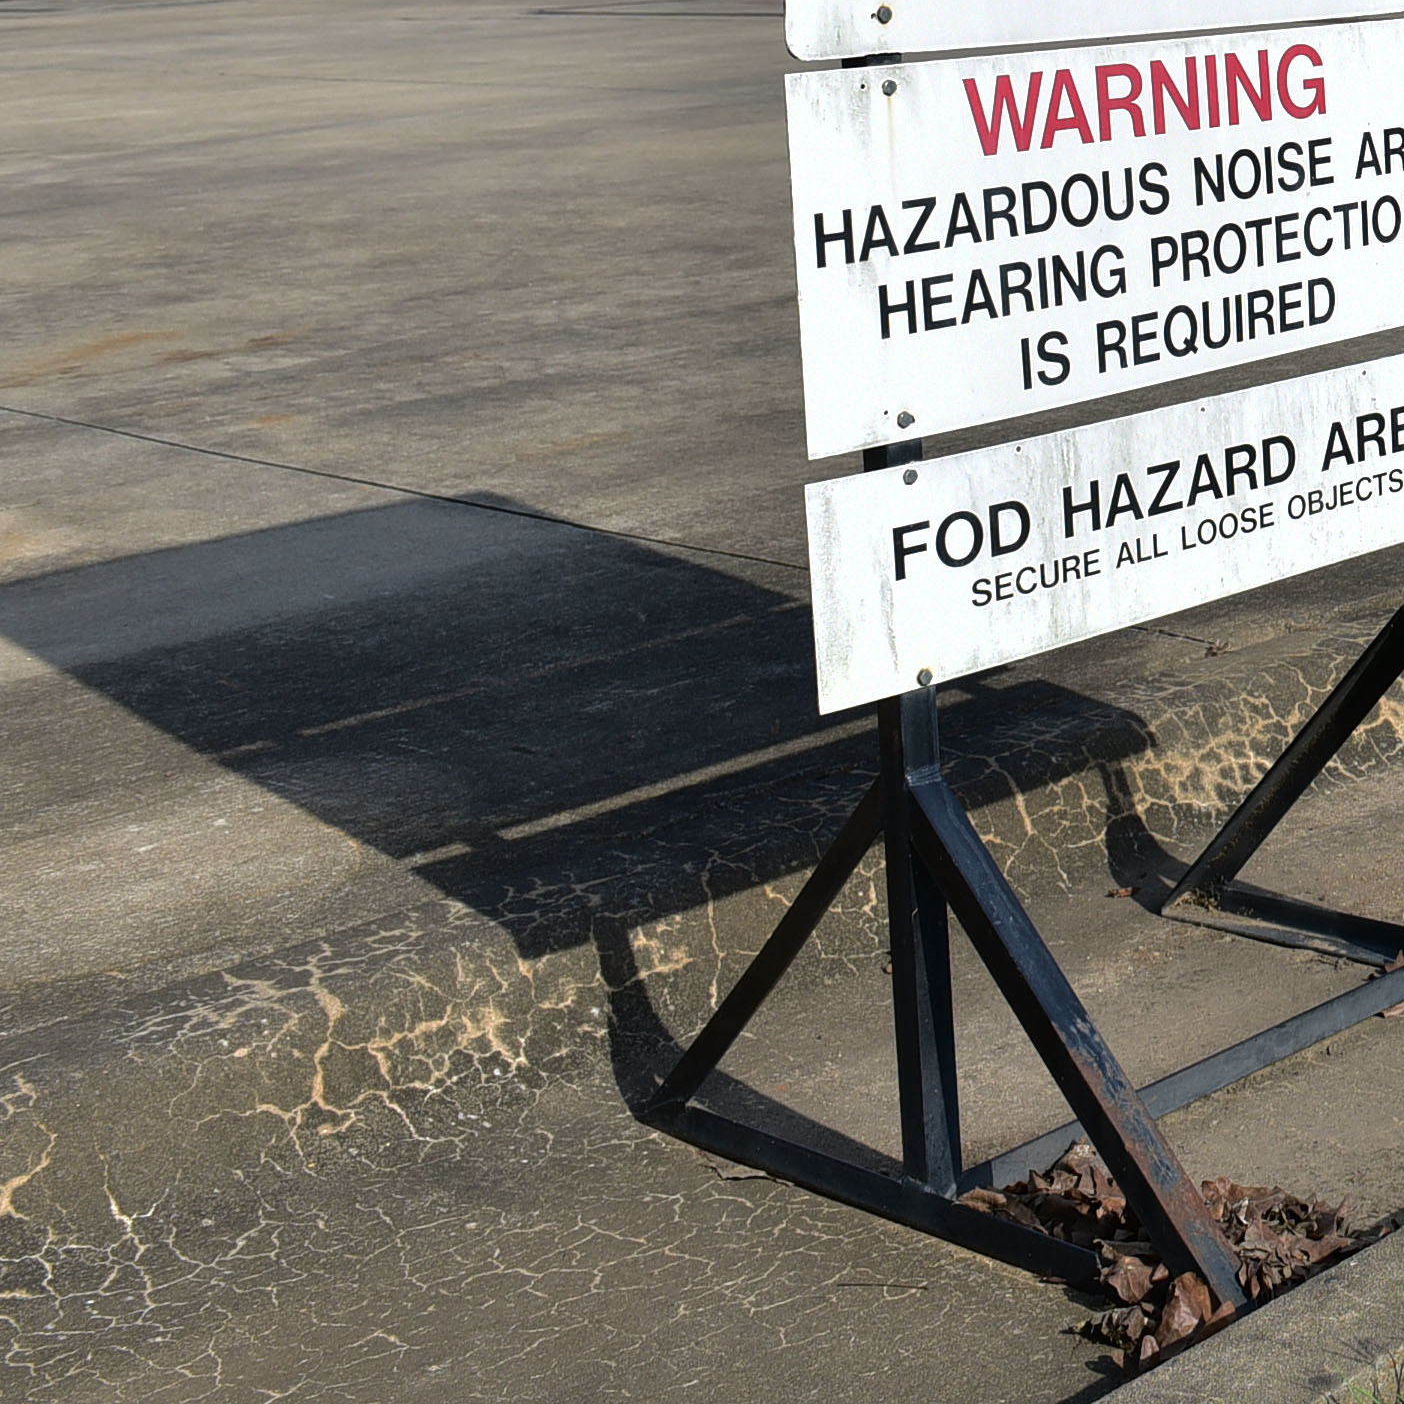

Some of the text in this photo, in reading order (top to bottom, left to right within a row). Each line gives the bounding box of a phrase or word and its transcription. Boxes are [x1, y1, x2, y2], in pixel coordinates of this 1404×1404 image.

[963, 44, 1327, 156] WARNING
[814, 162, 1169, 268] HAZARDOUS
[1194, 138, 1334, 206] NOISE
[878, 245, 1126, 339] HEARING
[1021, 278, 1336, 390] IS REQUIRED
[893, 501, 1030, 581] FOD
[1063, 436, 1295, 538] HAZARD
[971, 469, 1404, 606] SECURE ALL LOOSE OBJECTS
